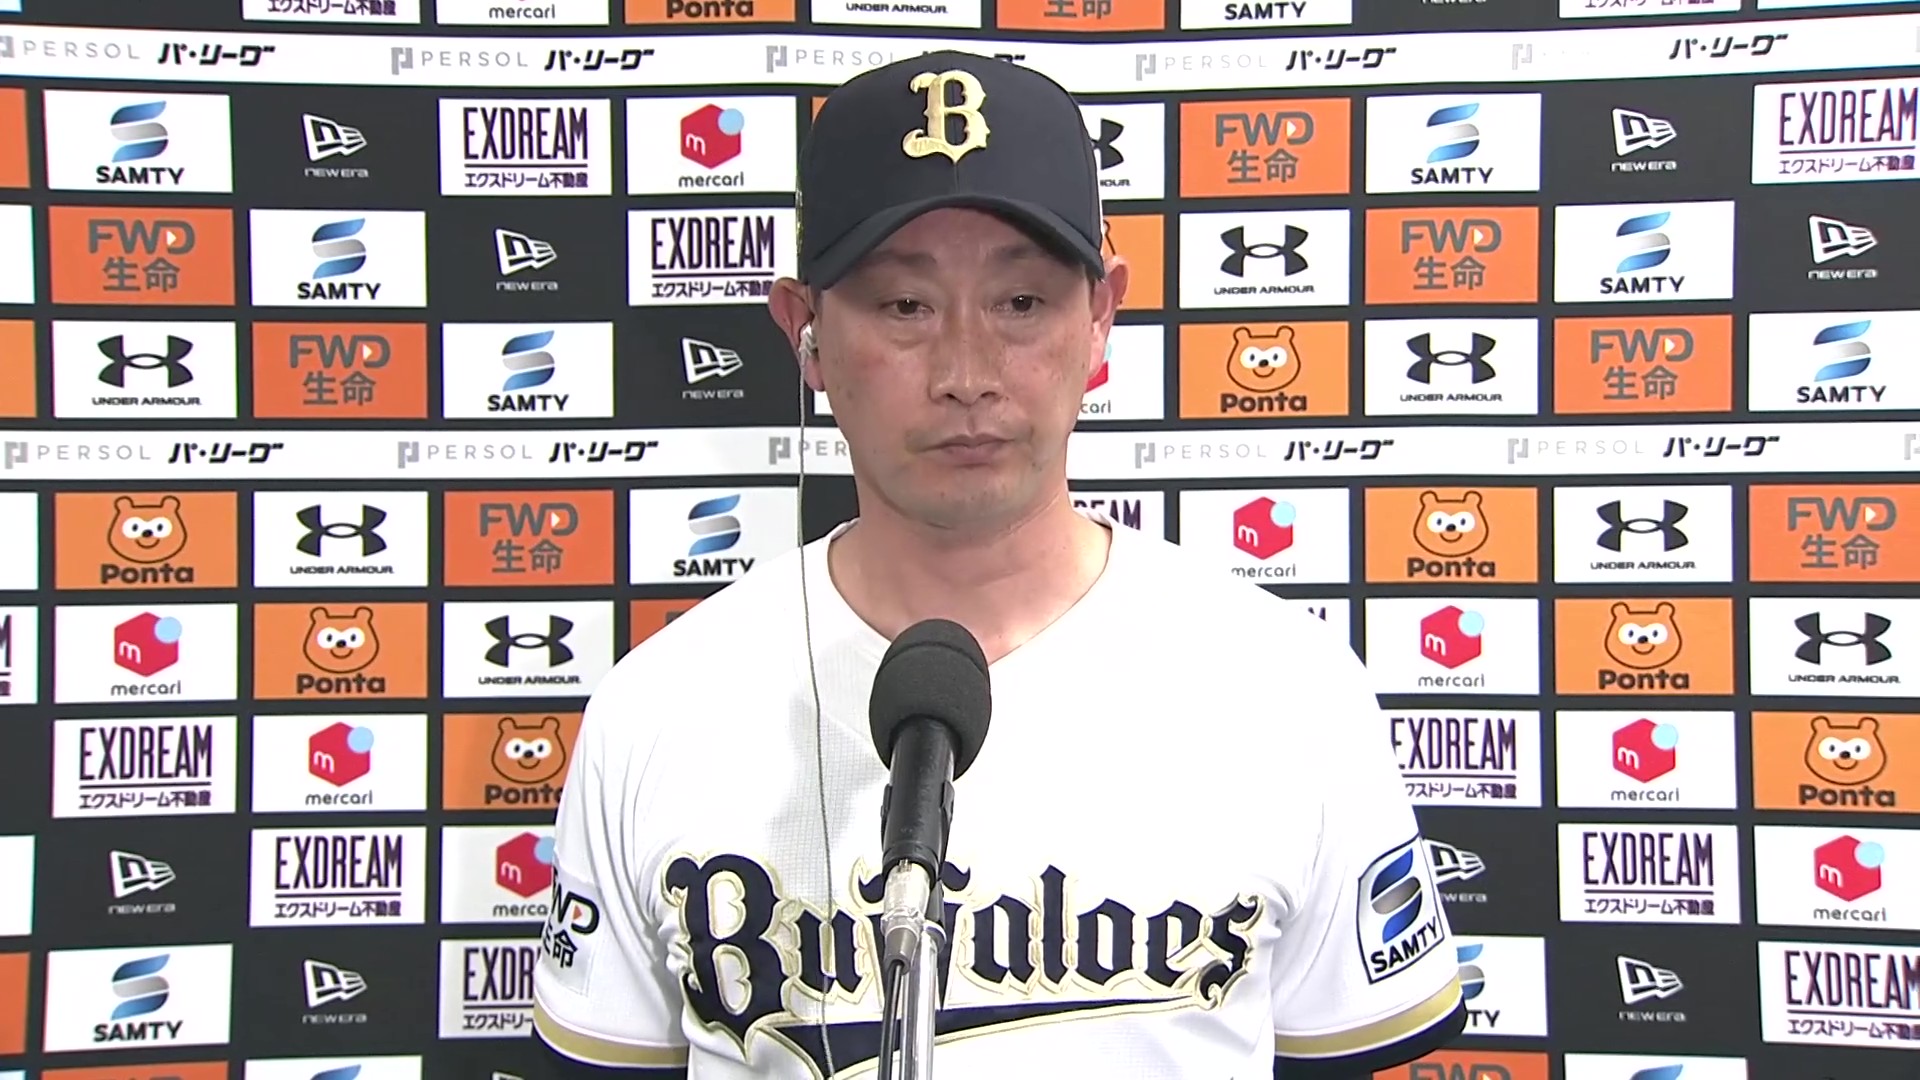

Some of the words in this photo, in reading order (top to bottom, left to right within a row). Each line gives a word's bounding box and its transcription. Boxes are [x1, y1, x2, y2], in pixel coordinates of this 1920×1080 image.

[489, 4, 555, 18] mercari
[667, 0, 754, 18] Ponta
[1225, 2, 1306, 20] SAMTY
[23, 40, 140, 59] PERSOL
[158, 43, 275, 66] パ・リーグ
[1669, 34, 1788, 59] パ・リーグ
[422, 51, 528, 67] PERSOL
[544, 49, 654, 71] パ・リーグ
[1165, 55, 1266, 70] PERSOL
[1286, 48, 1396, 70] パ・リーグ
[903, 69, 990, 165] B
[1779, 88, 1918, 147] EXDREAM
[463, 107, 588, 159] EXDREAM
[1216, 111, 1315, 149] FWD
[96, 166, 184, 184] SAMTY
[1227, 148, 1298, 183] 生命
[1411, 167, 1493, 184] SAMTY
[679, 172, 744, 187] mercari
[88, 219, 195, 255] FWD
[651, 216, 774, 270] EXDREAM
[1401, 219, 1502, 254] FWD
[102, 256, 180, 293] 生命
[1413, 256, 1486, 290] 生命
[298, 282, 381, 299] SAMTY
[1600, 276, 1684, 294] SAMTY
[290, 335, 391, 369] FWD
[1591, 328, 1694, 364] FWD
[302, 371, 376, 406] 生命
[1603, 365, 1678, 400] 生命
[488, 394, 569, 411] SAMTY
[1221, 391, 1307, 413] Ponta
[1797, 386, 1886, 403] SAMTY
[1080, 400, 1112, 414] cari
[38, 445, 150, 460] PERSOL
[168, 443, 284, 463] パ・リーグ
[428, 445, 532, 459] PERSOL
[549, 441, 658, 463] パ・リーグ
[1164, 444, 1266, 459] PERSOL
[1284, 440, 1394, 461] パ・リーグ
[1537, 440, 1645, 455] PERSOL
[1663, 436, 1780, 457] パ・リーグ
[480, 503, 579, 537] FWD
[1788, 497, 1897, 531] FWD
[492, 539, 563, 574] 生命
[1801, 534, 1880, 570] 生命
[101, 560, 194, 584] Ponta
[1407, 555, 1495, 577] Ponta
[111, 680, 181, 695] mercari
[297, 670, 385, 694] Ponta
[1418, 674, 1484, 687] mercari
[1598, 667, 1689, 690] Ponta
[79, 725, 212, 781] EXDREAM
[305, 791, 372, 805] mercari
[1611, 788, 1679, 801] mercari
[1799, 782, 1895, 807] Ponta
[275, 835, 402, 890] EXDREAM
[1583, 832, 1713, 886] EXDREAM
[493, 904, 547, 916] merca
[1814, 908, 1886, 921] mercari
[660, 851, 1268, 1060] Bualoes
[1370, 916, 1437, 974] SAMTY
[464, 947, 541, 1001] EXDR
[1785, 950, 1920, 1010] EXDREAM
[94, 1020, 183, 1043] SAMTY
